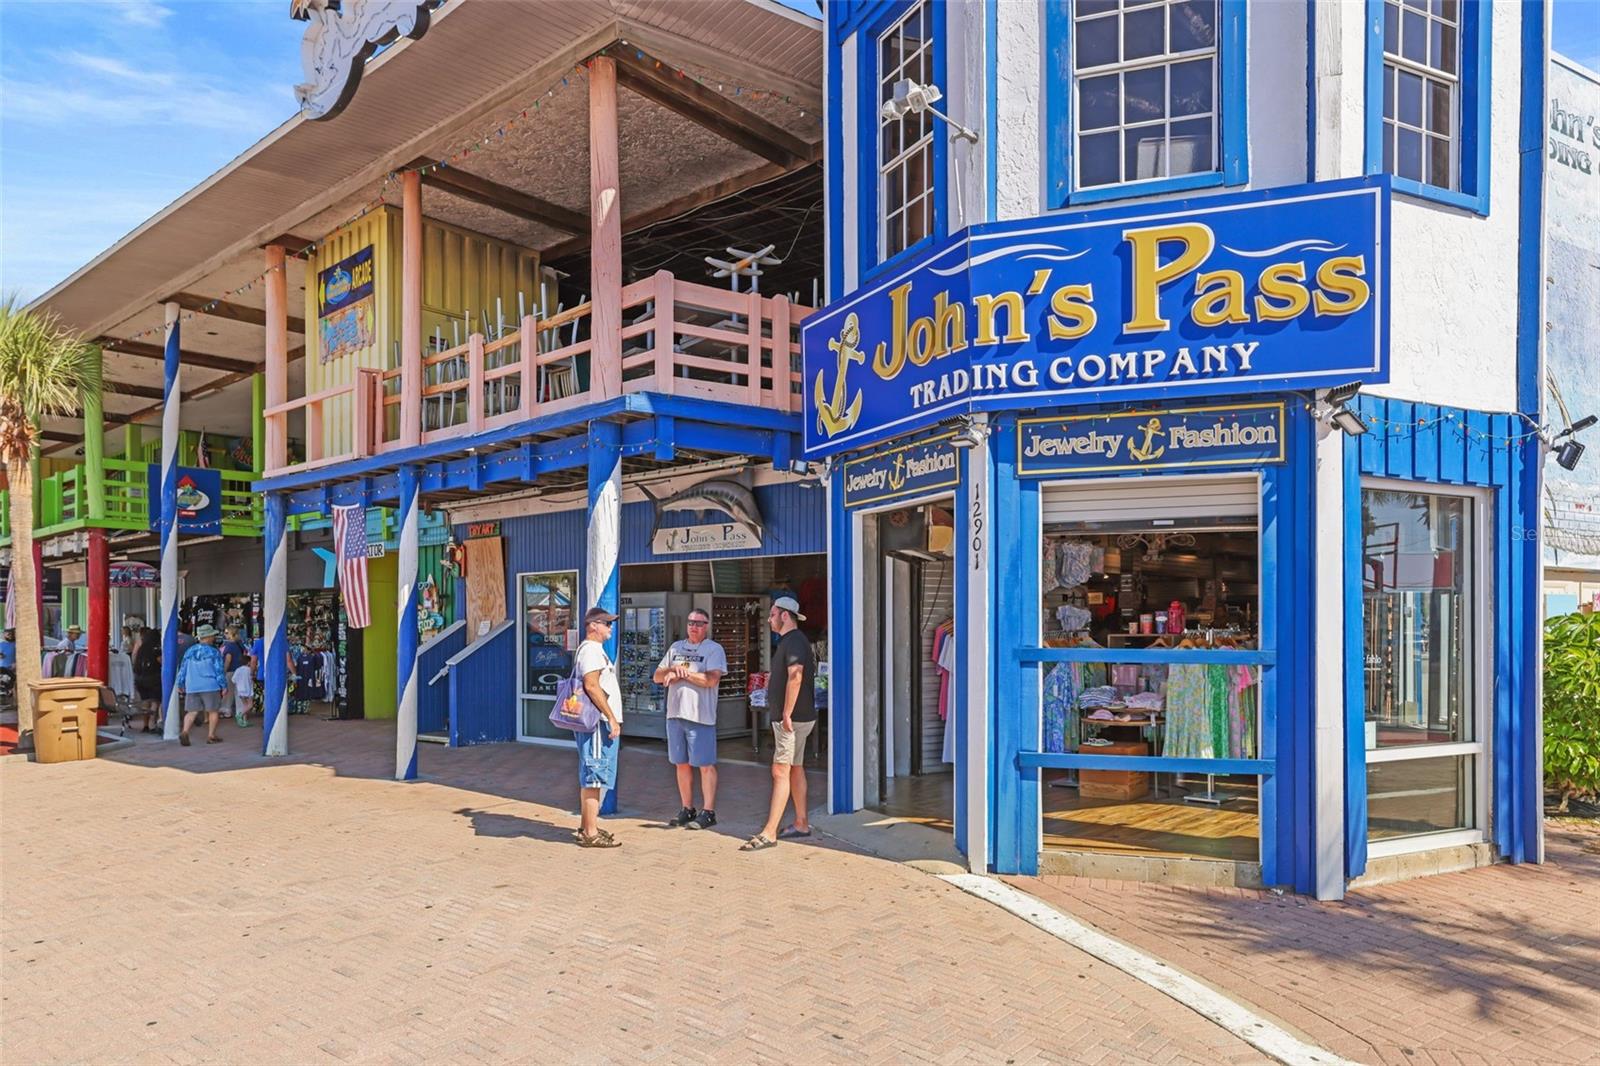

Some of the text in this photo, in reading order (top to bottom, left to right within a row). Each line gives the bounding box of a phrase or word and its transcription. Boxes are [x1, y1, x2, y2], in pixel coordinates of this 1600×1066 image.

[872, 221, 1370, 380] John's Pass
[909, 341, 1260, 408] TRADING COMPANY
[1025, 422, 1277, 458] Jewelry Fashion
[847, 450, 956, 493] Jewelry Fashion
[681, 524, 747, 545] John's Pass
[972, 483, 983, 571] 12901
